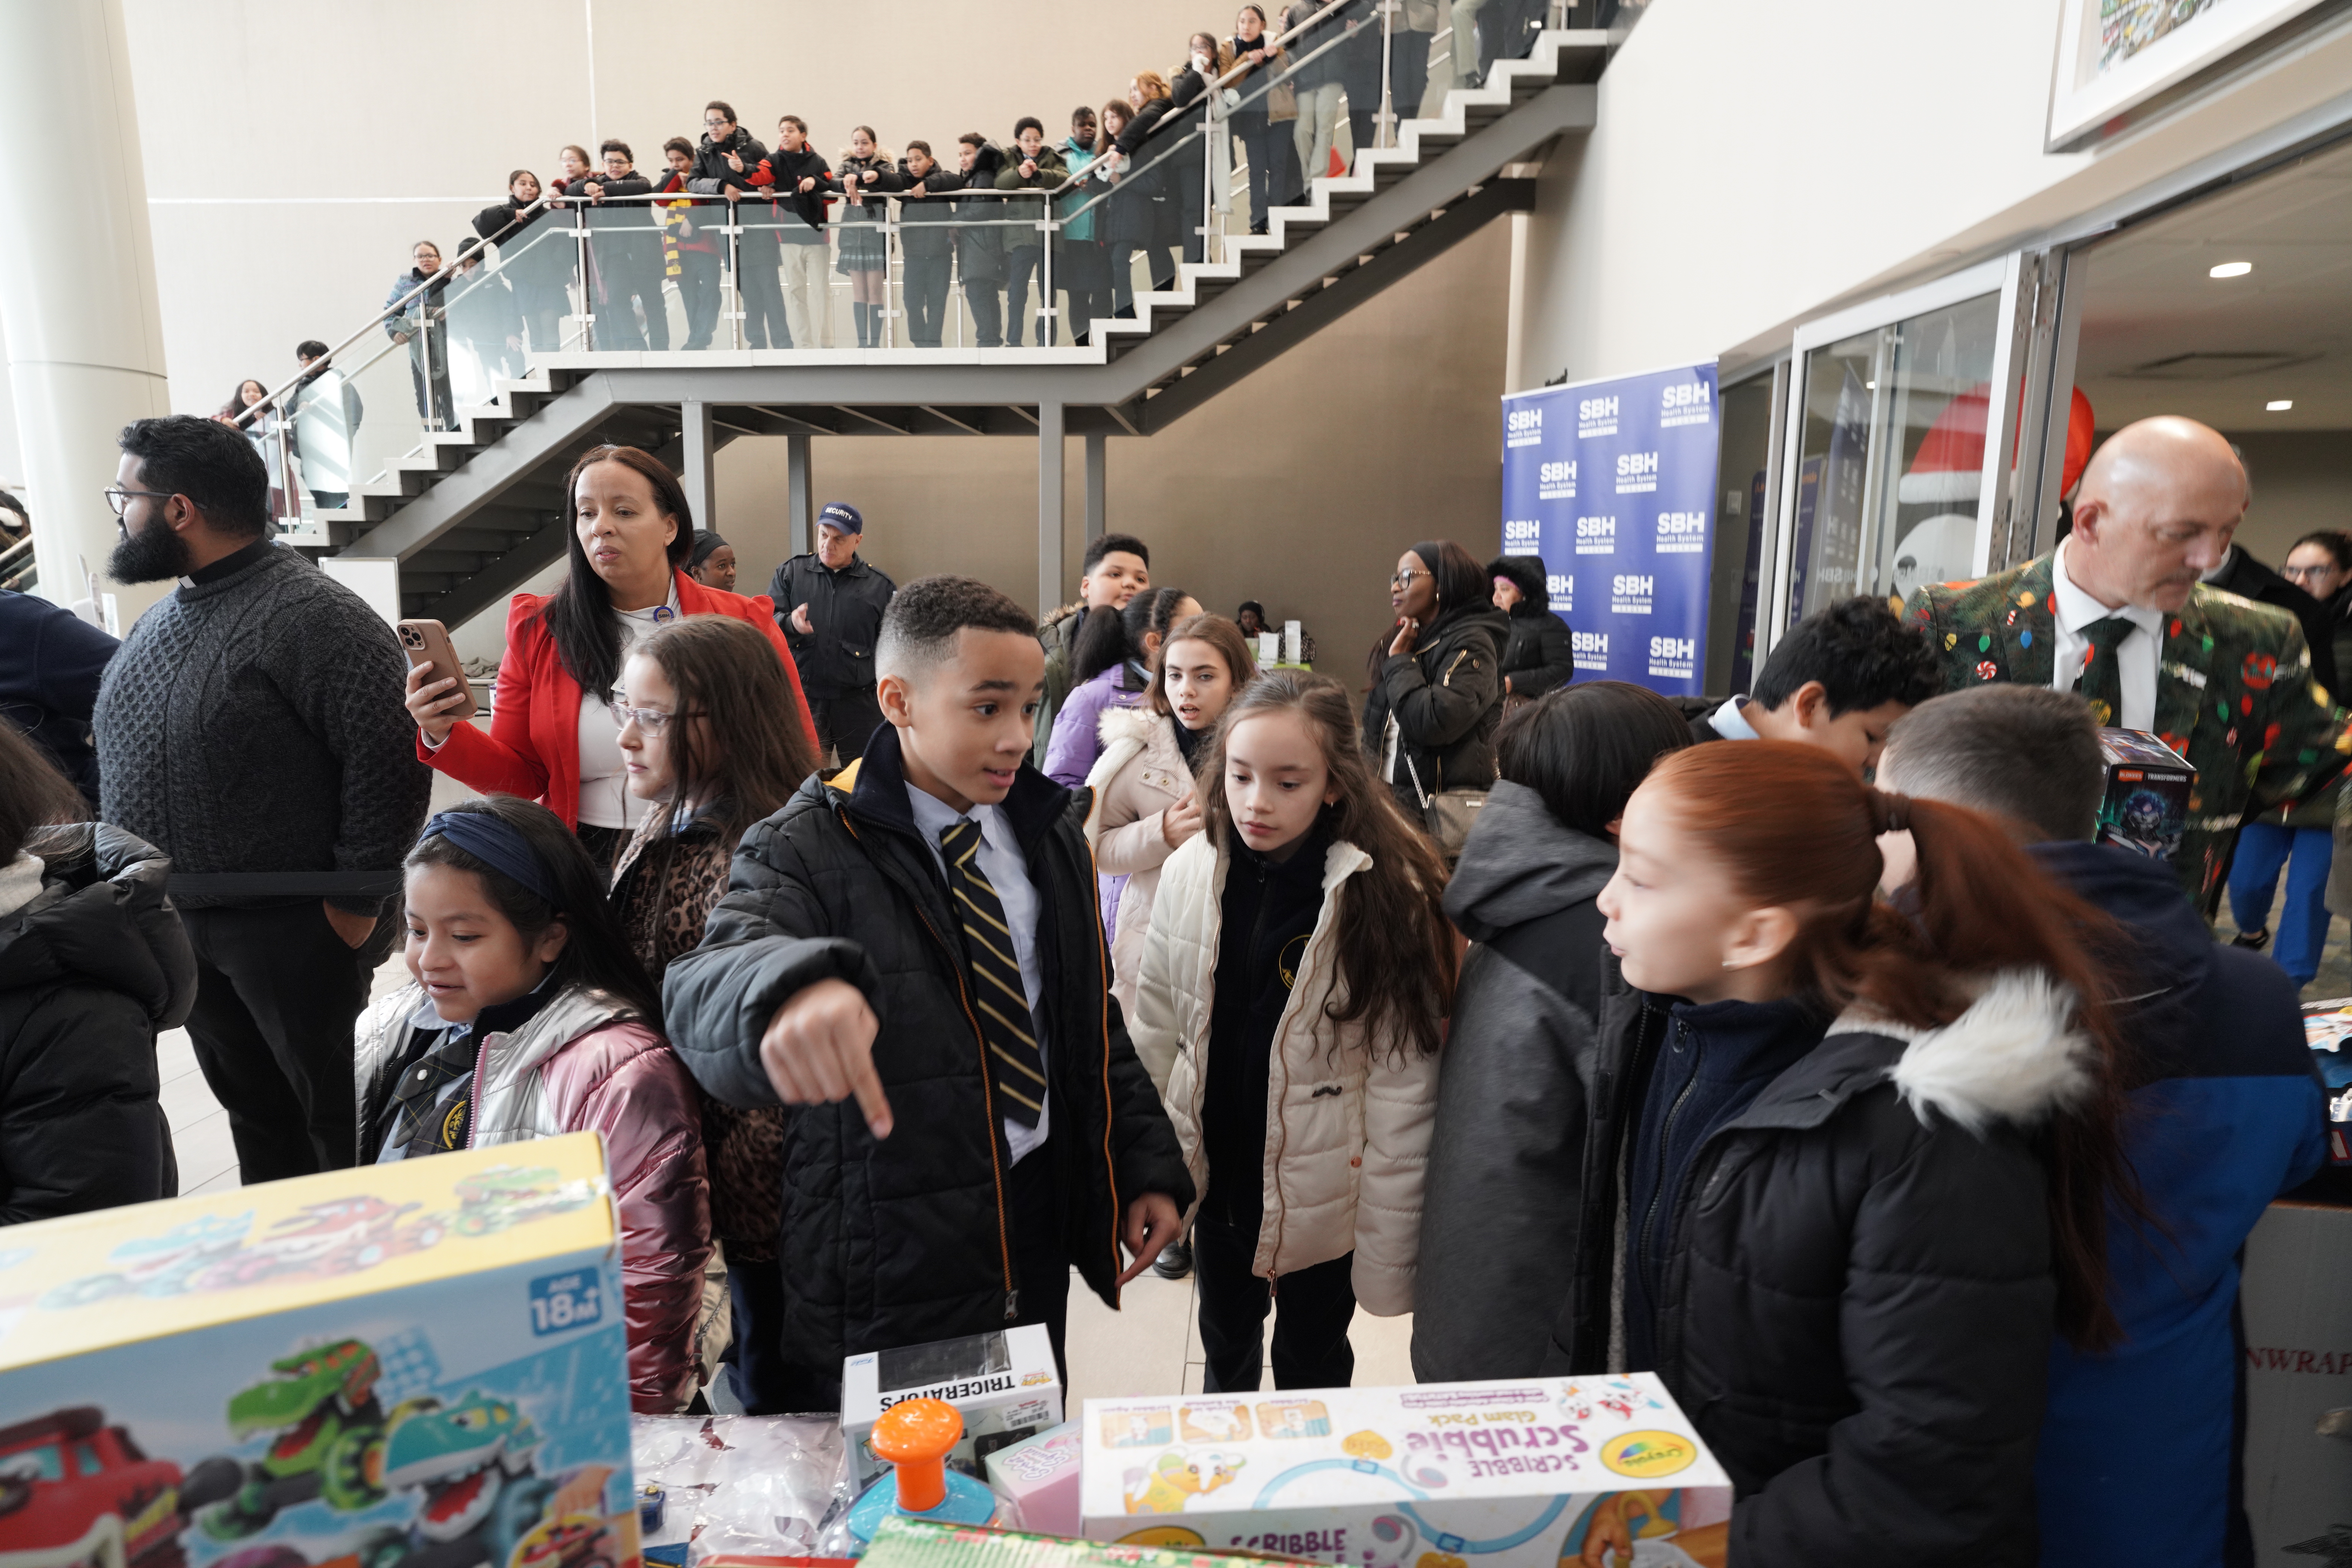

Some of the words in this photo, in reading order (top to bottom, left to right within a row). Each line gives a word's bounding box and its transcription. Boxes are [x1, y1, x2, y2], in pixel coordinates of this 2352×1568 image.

[1662, 381, 1710, 408] SBH
[1579, 395, 1619, 420] SBH
[1661, 408, 1681, 417] Health
[1683, 404, 1709, 414] System
[1508, 409, 1542, 431] SBH
[1579, 420, 1595, 429] Health
[1597, 417, 1617, 429] System
[1508, 431, 1522, 439] Health
[1524, 429, 1541, 437] System
[1540, 461, 1577, 482] SBH
[1617, 452, 1658, 475] SBH
[1540, 482, 1556, 490] Health
[1557, 481, 1576, 490] System
[1617, 476, 1635, 484] Health
[1637, 474, 1657, 483] System
[825, 507, 852, 520] SECURITY
[1505, 520, 1540, 539] SBH
[1577, 516, 1615, 537] SBH
[1657, 512, 1705, 534] SBH
[1522, 539, 1539, 547] System
[1594, 537, 1614, 545] System
[1678, 534, 1703, 543] System
[1547, 575, 1573, 593] BH
[1613, 575, 1653, 596] SBH
[1612, 596, 1631, 604] Health
[1632, 596, 1652, 605] System
[1572, 632, 1608, 653] SBH
[1650, 636, 1694, 659] SBH
[1588, 653, 1607, 662] System
[1649, 657, 1667, 667] Health
[1669, 659, 1693, 669] System
[2148, 773, 2187, 782] TRANSFORMERS
[1427, 1413, 1479, 1427] Pack
[1484, 1410, 1536, 1424] Glam
[1406, 1425, 1590, 1462] Scrubbie
[1019, 1448, 1066, 1468] Squad
[1468, 1454, 1581, 1477] SCRIBBLE
